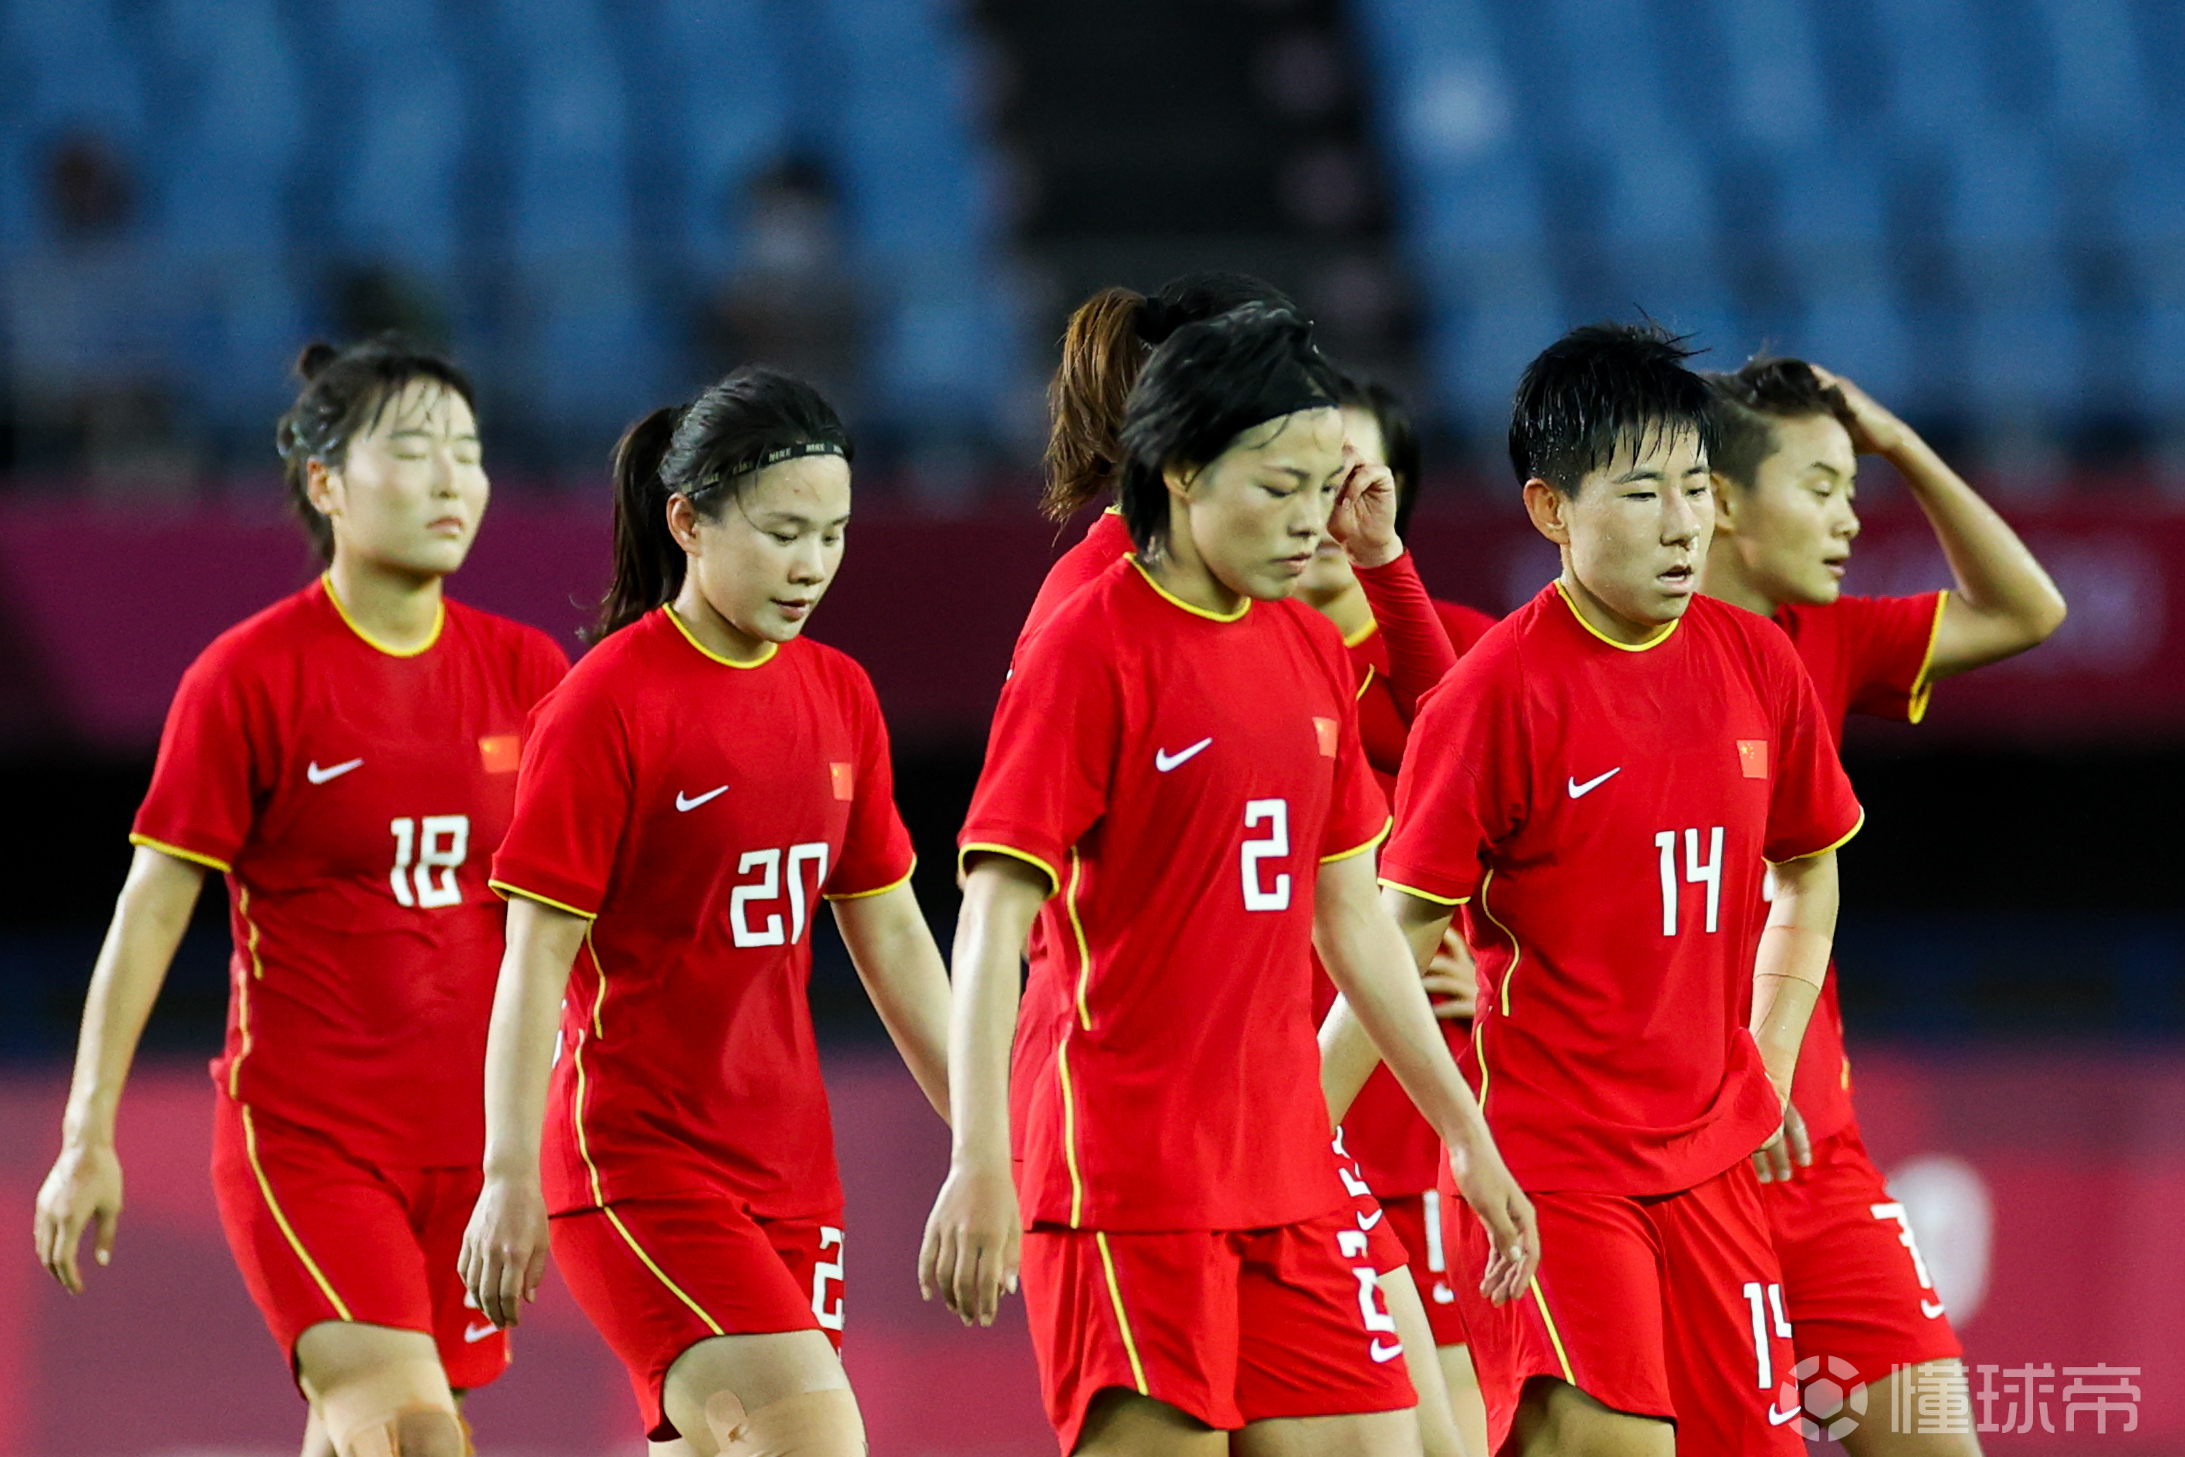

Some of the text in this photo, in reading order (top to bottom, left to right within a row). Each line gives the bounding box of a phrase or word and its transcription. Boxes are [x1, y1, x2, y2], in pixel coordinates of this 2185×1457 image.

[389, 815, 469, 908] 18
[729, 842, 829, 948] 20
[1240, 798, 1290, 911] 2
[1655, 826, 1724, 936] 14
